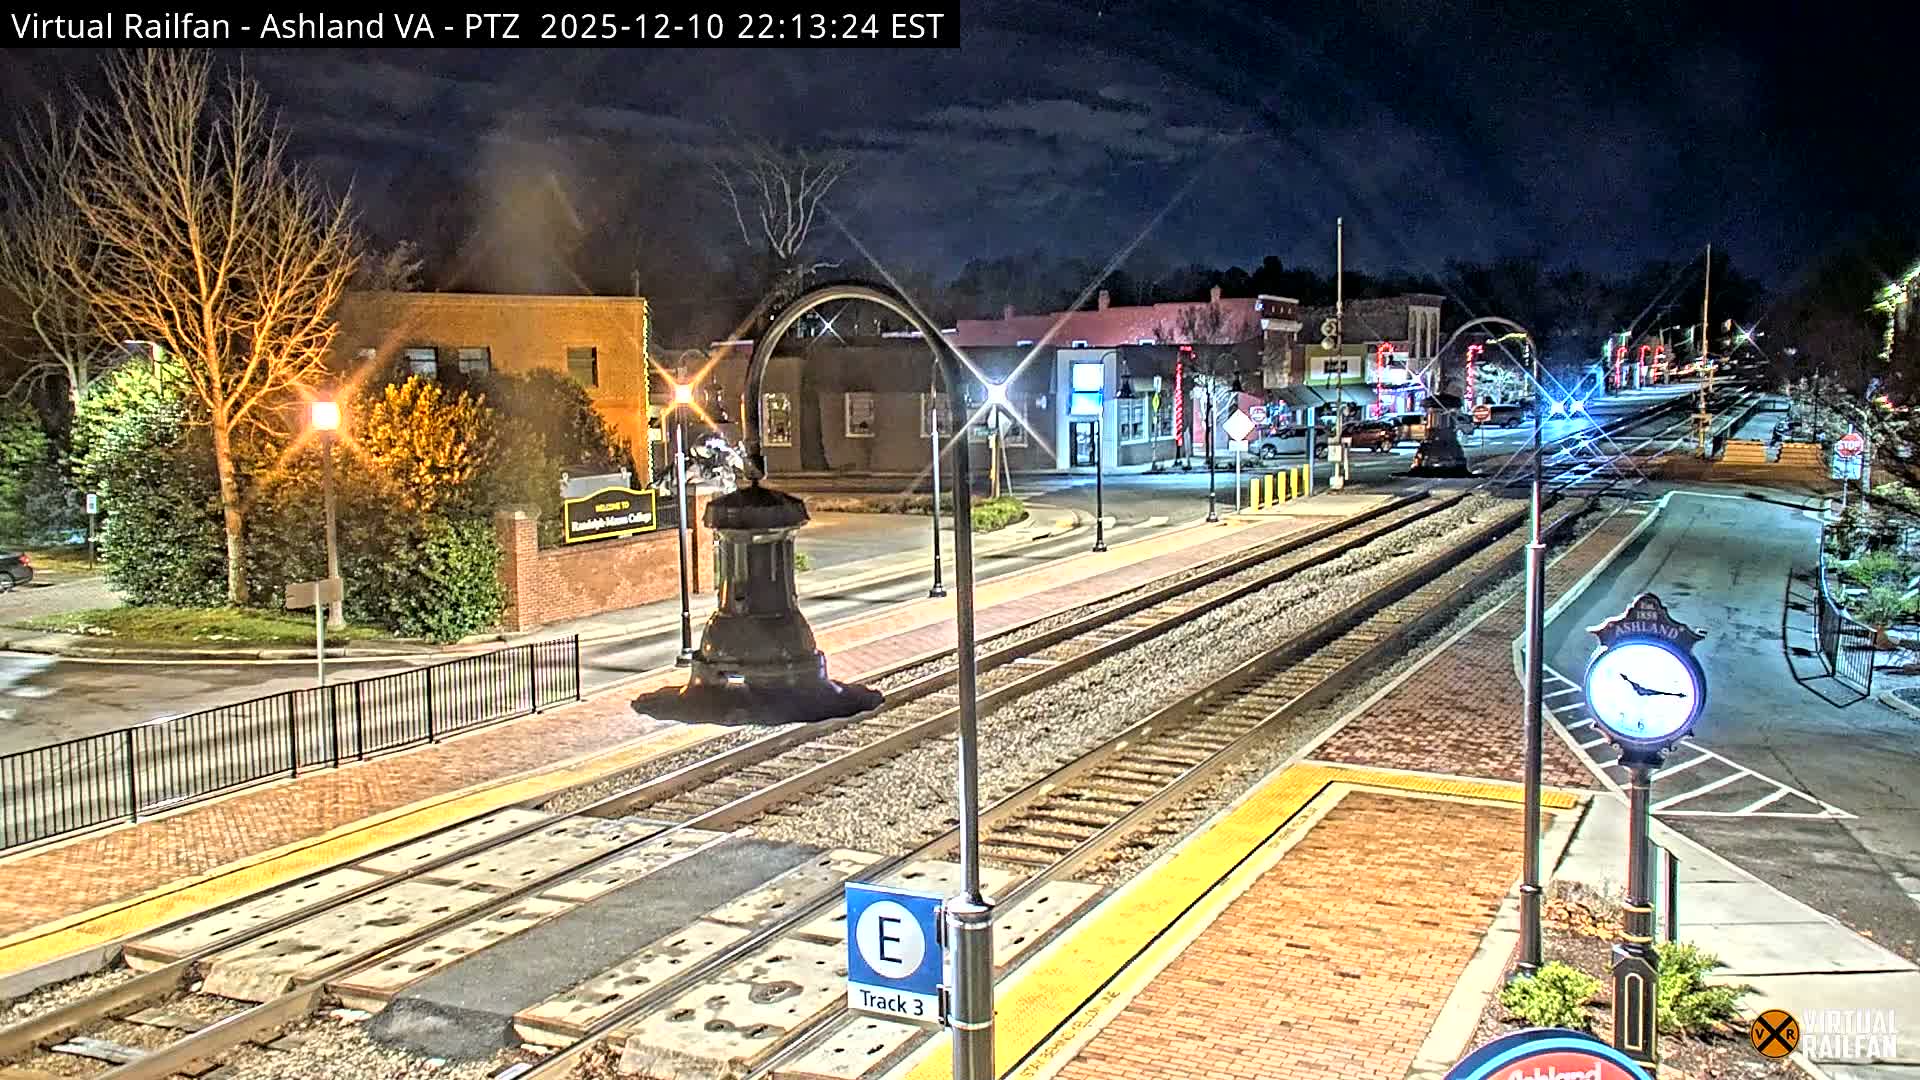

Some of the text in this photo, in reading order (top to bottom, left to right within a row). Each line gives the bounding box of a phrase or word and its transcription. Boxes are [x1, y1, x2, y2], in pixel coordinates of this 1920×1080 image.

[1616, 621, 1679, 639] ASHLAND
[879, 916, 902, 964] E
[860, 989, 924, 1016] Track 3
[1508, 1062, 1601, 1080] Ahland
